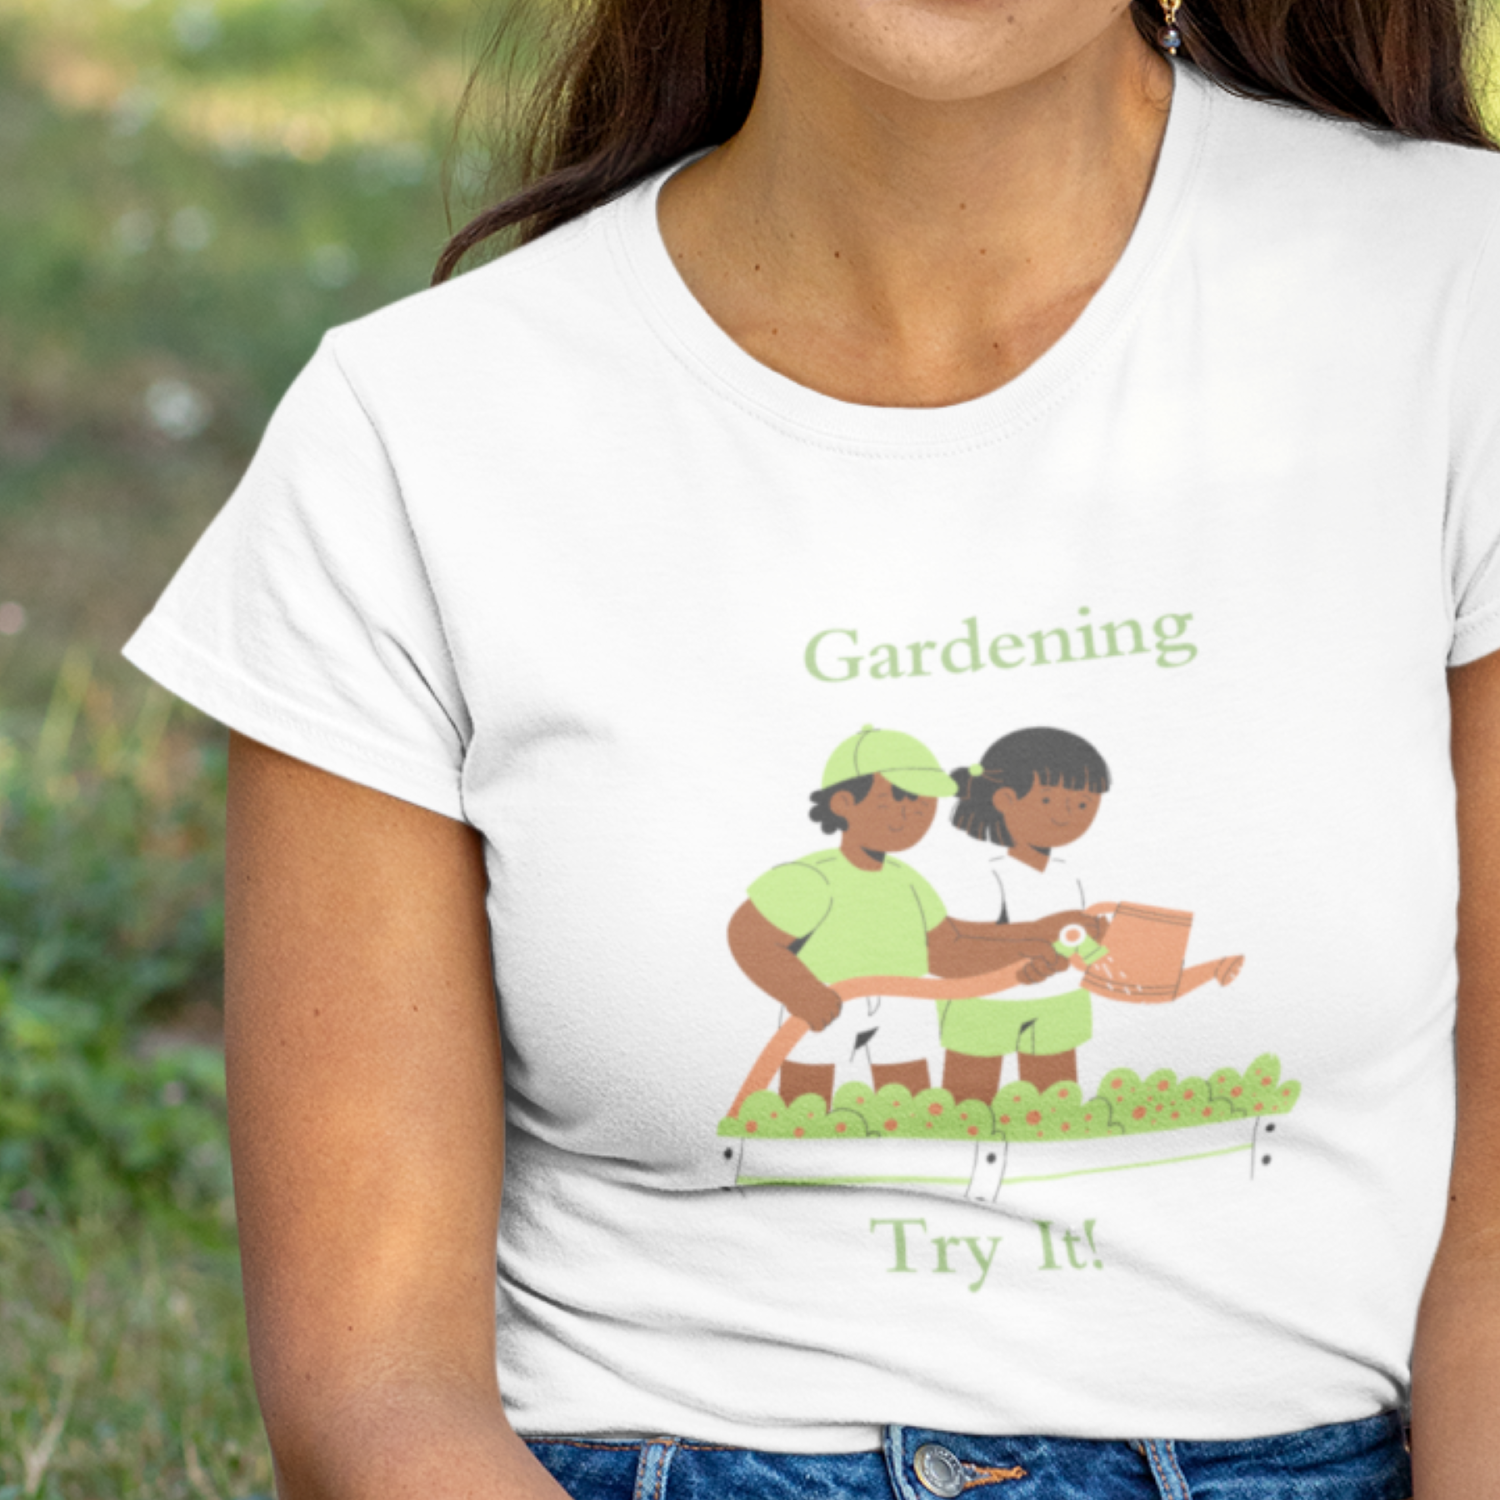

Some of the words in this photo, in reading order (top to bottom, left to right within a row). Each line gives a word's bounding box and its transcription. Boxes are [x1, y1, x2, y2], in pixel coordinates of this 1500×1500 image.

[803, 606, 1198, 683] Gardening
[869, 1218, 1002, 1293] Try
[1031, 1218, 1104, 1270] It!
